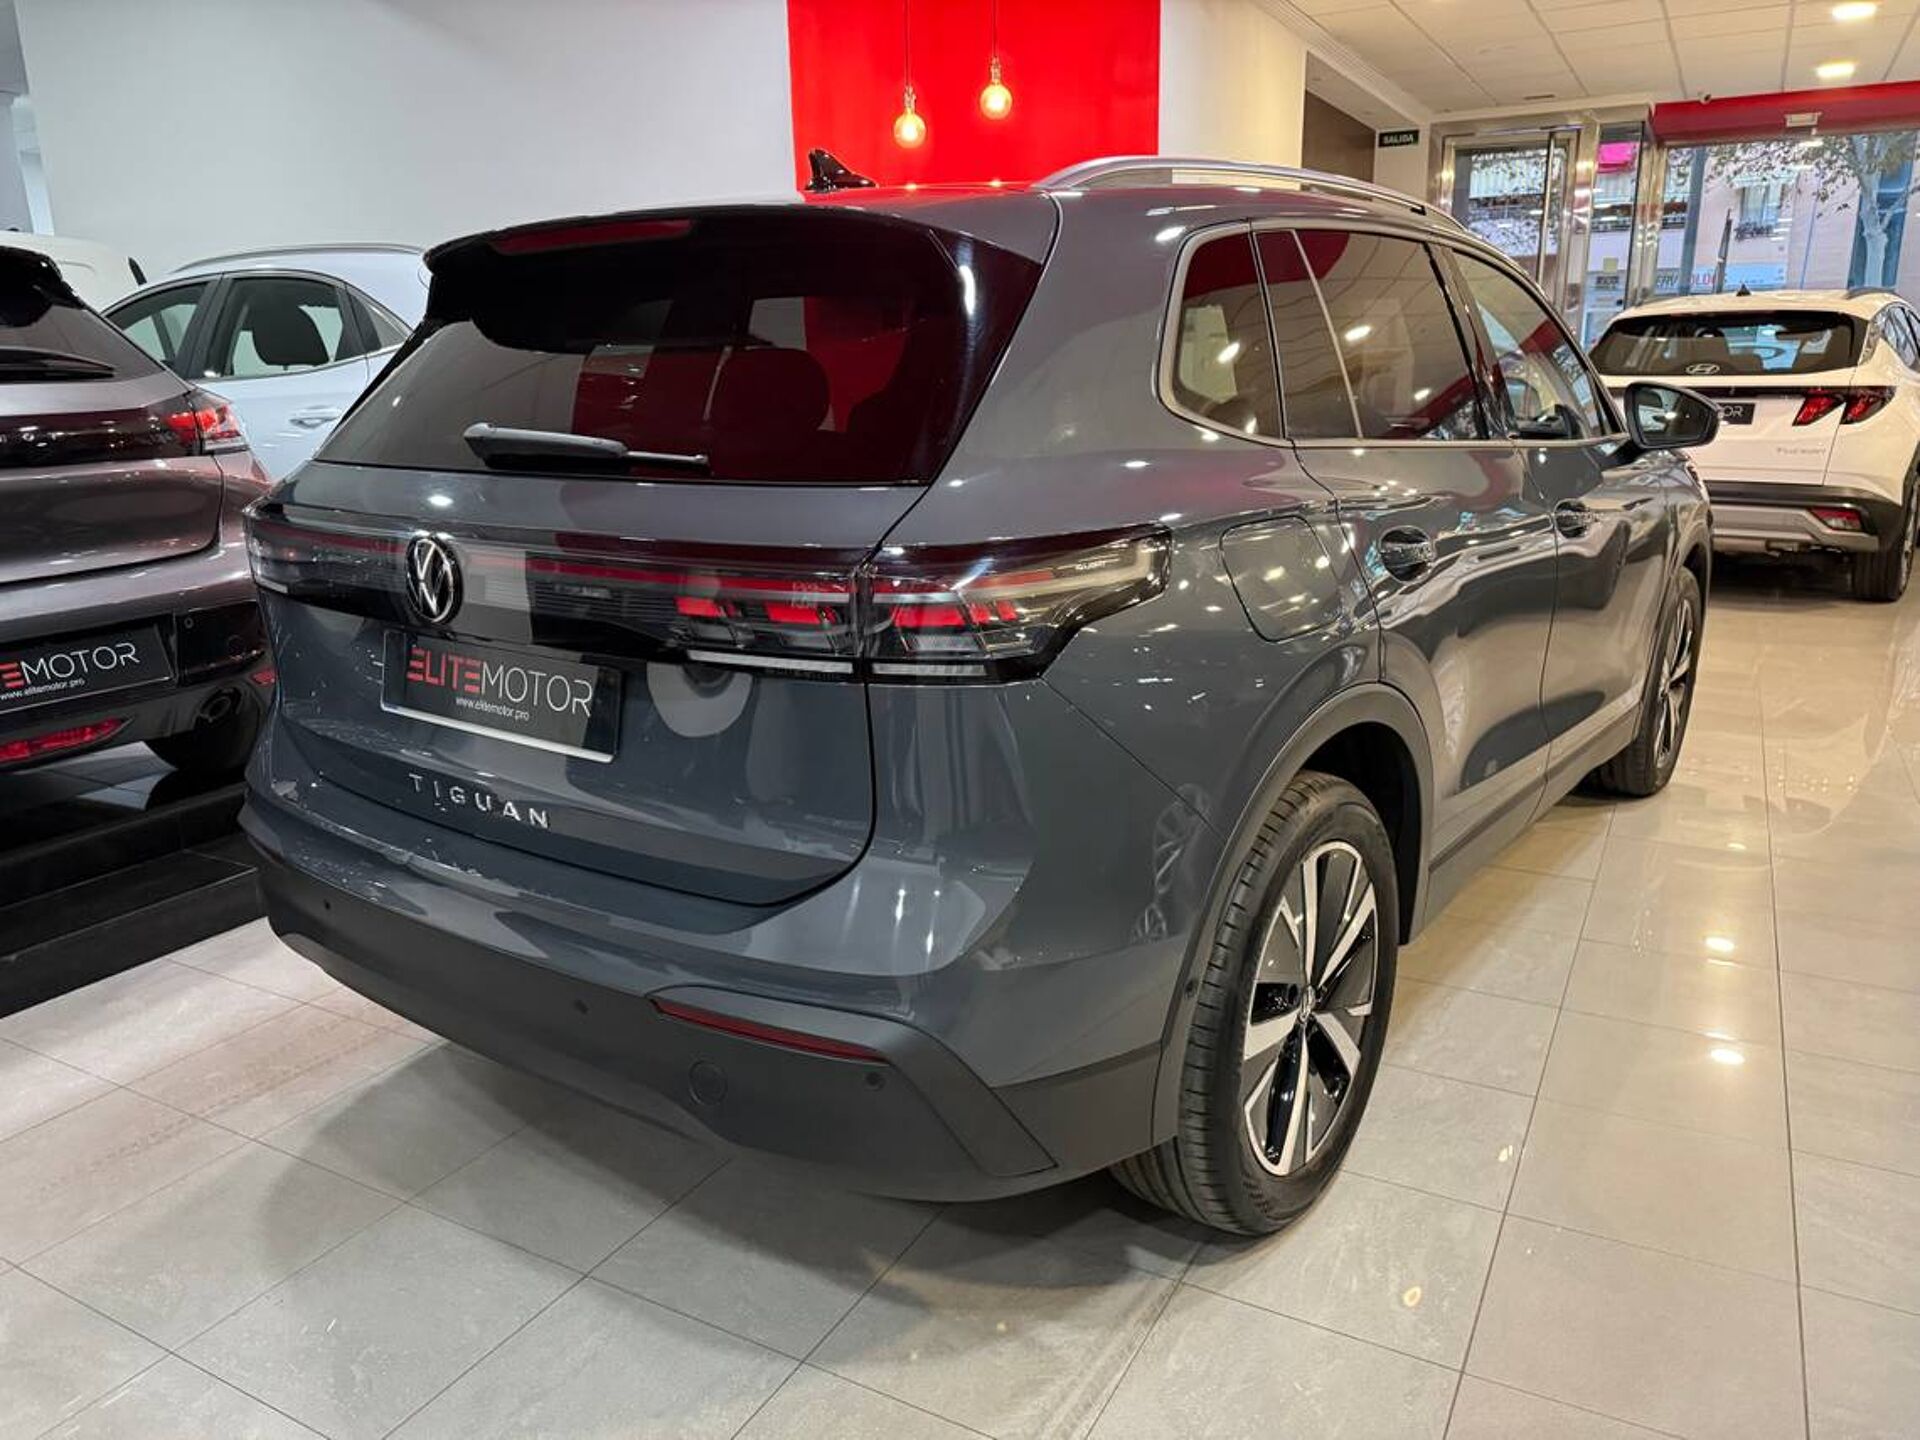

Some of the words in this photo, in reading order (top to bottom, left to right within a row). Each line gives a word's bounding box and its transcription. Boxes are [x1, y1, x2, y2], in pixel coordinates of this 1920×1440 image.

[1383, 133, 1414, 145] SALIDA
[1723, 405, 1744, 417] OR
[406, 647, 594, 718] ELITEMOTOR
[455, 696, 530, 721] www.elitemotor.pro
[408, 772, 549, 829] TIGUAN
